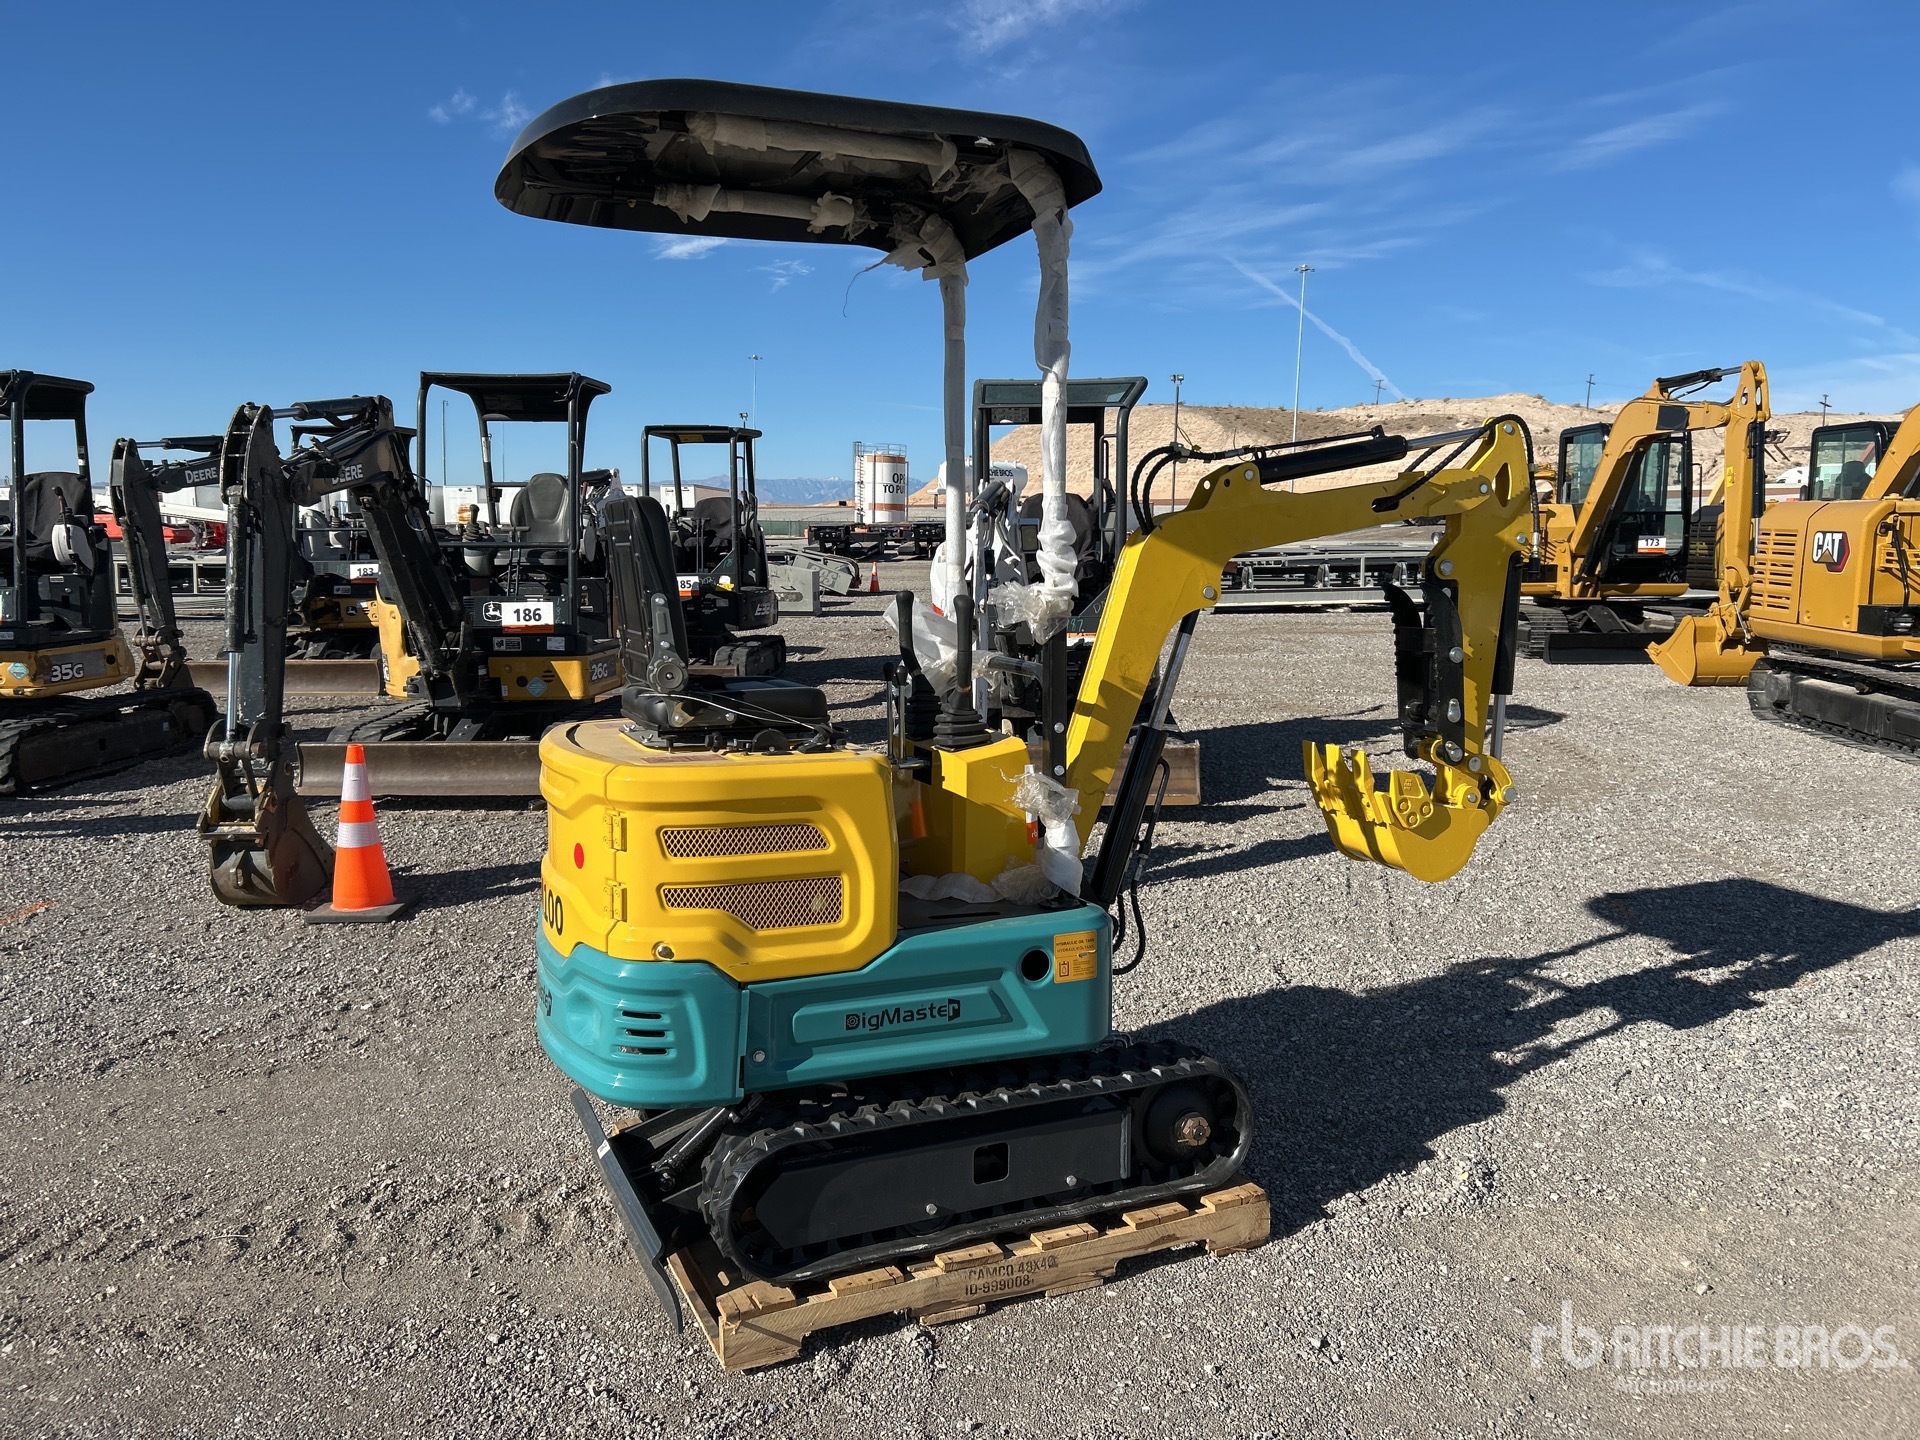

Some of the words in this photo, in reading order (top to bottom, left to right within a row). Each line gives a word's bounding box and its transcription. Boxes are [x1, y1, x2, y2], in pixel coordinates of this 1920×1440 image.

[184, 466, 218, 484] DEERE
[883, 484, 895, 494] TO
[1644, 538, 1660, 547] 173
[1812, 531, 1843, 563] CAT
[357, 567, 374, 577] 183
[680, 579, 692, 589] 85
[513, 607, 542, 622] 186
[51, 662, 84, 682] 35G
[591, 662, 608, 681] 26G
[845, 998, 961, 1032] DigMaster
[968, 1264, 1014, 1281] CAMCO
